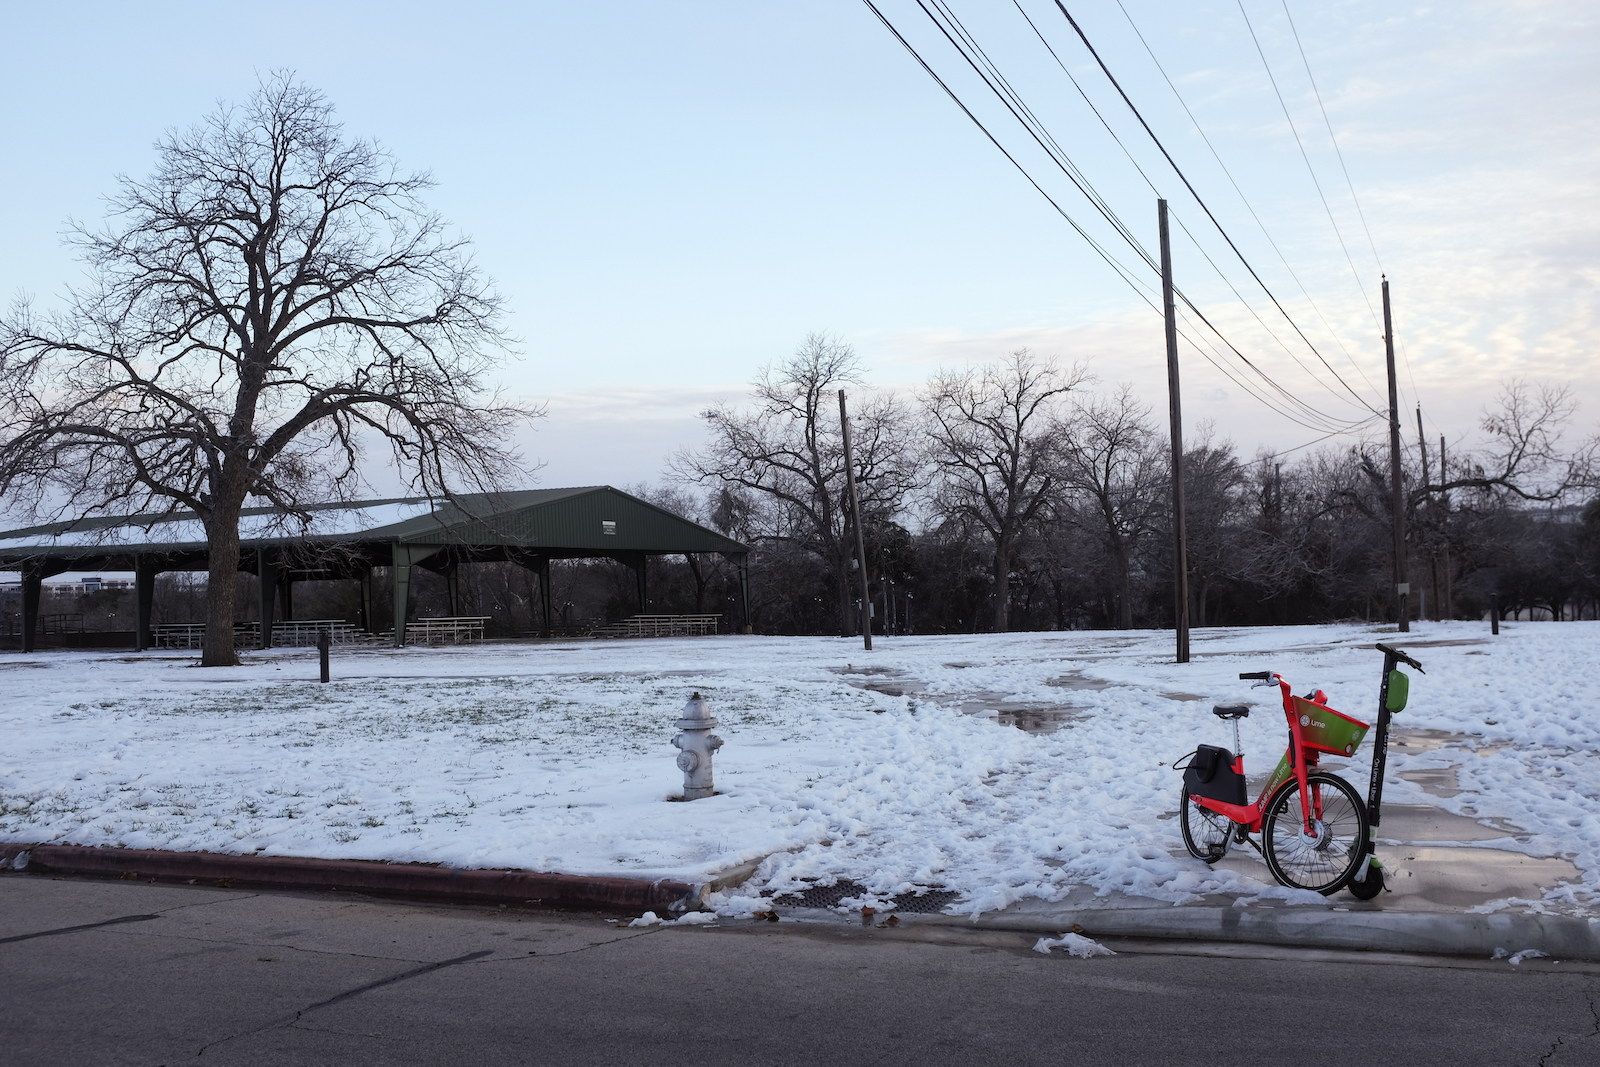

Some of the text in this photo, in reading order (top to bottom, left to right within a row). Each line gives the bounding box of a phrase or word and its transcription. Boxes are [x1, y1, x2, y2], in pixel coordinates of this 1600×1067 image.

[1311, 720, 1325, 728] Lime
[1374, 758, 1380, 768] On
[1270, 777, 1279, 790] now
[1277, 763, 1288, 779] Lime
